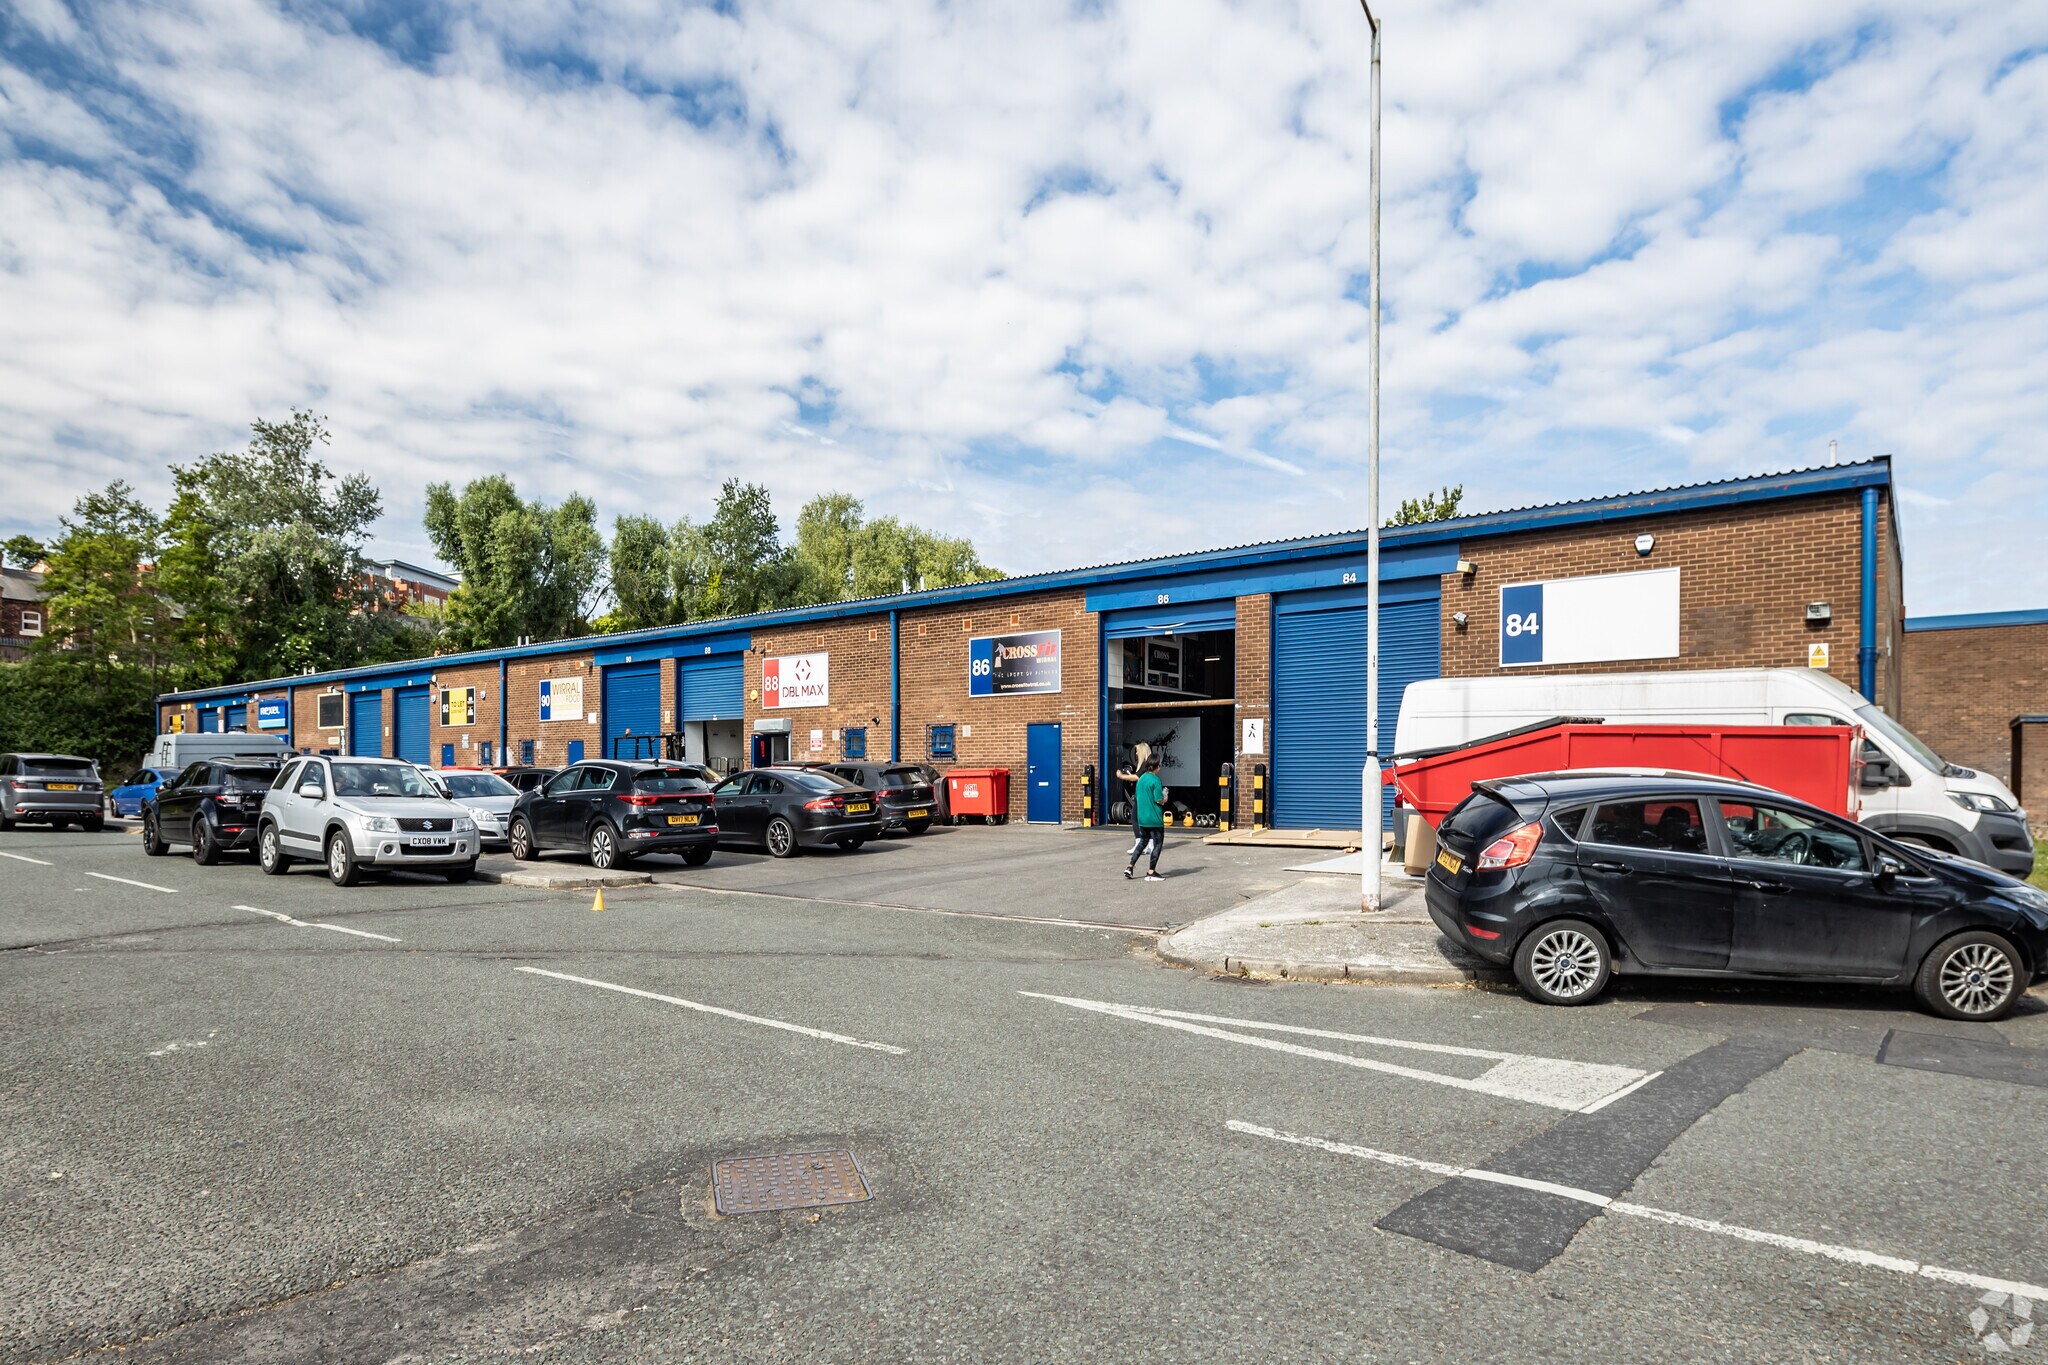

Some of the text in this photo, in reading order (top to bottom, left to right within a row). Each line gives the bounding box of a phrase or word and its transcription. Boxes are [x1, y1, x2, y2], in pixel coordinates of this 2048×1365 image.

[1342, 572, 1356, 584] 84
[1157, 594, 1169, 605] 86
[1506, 612, 1539, 637] 84
[972, 658, 990, 676] 86
[552, 682, 580, 696] WIRRAL
[764, 675, 779, 692] 88
[782, 684, 824, 698] DBL MAX
[541, 694, 551, 707] 90
[565, 694, 581, 704] FOOD
[412, 837, 432, 845] CX08
